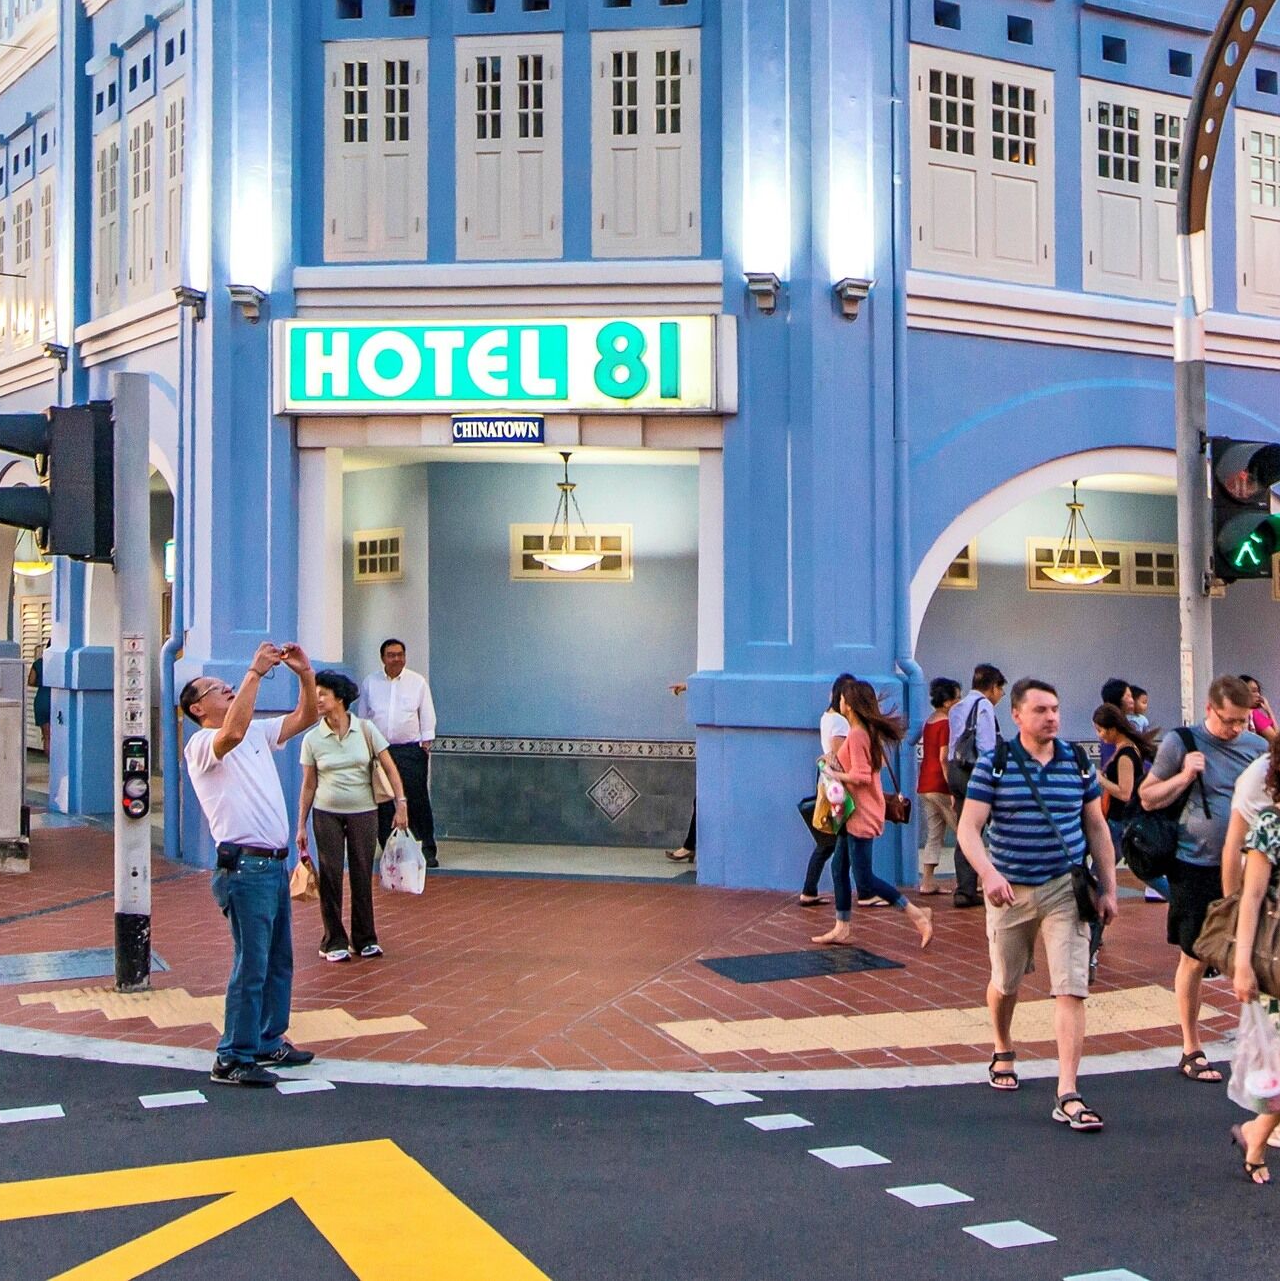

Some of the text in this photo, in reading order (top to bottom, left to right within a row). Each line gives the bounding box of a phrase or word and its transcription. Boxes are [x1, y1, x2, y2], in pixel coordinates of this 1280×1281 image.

[305, 321, 681, 401] HOTEL 81
[453, 421, 540, 439] CHINATOWN
